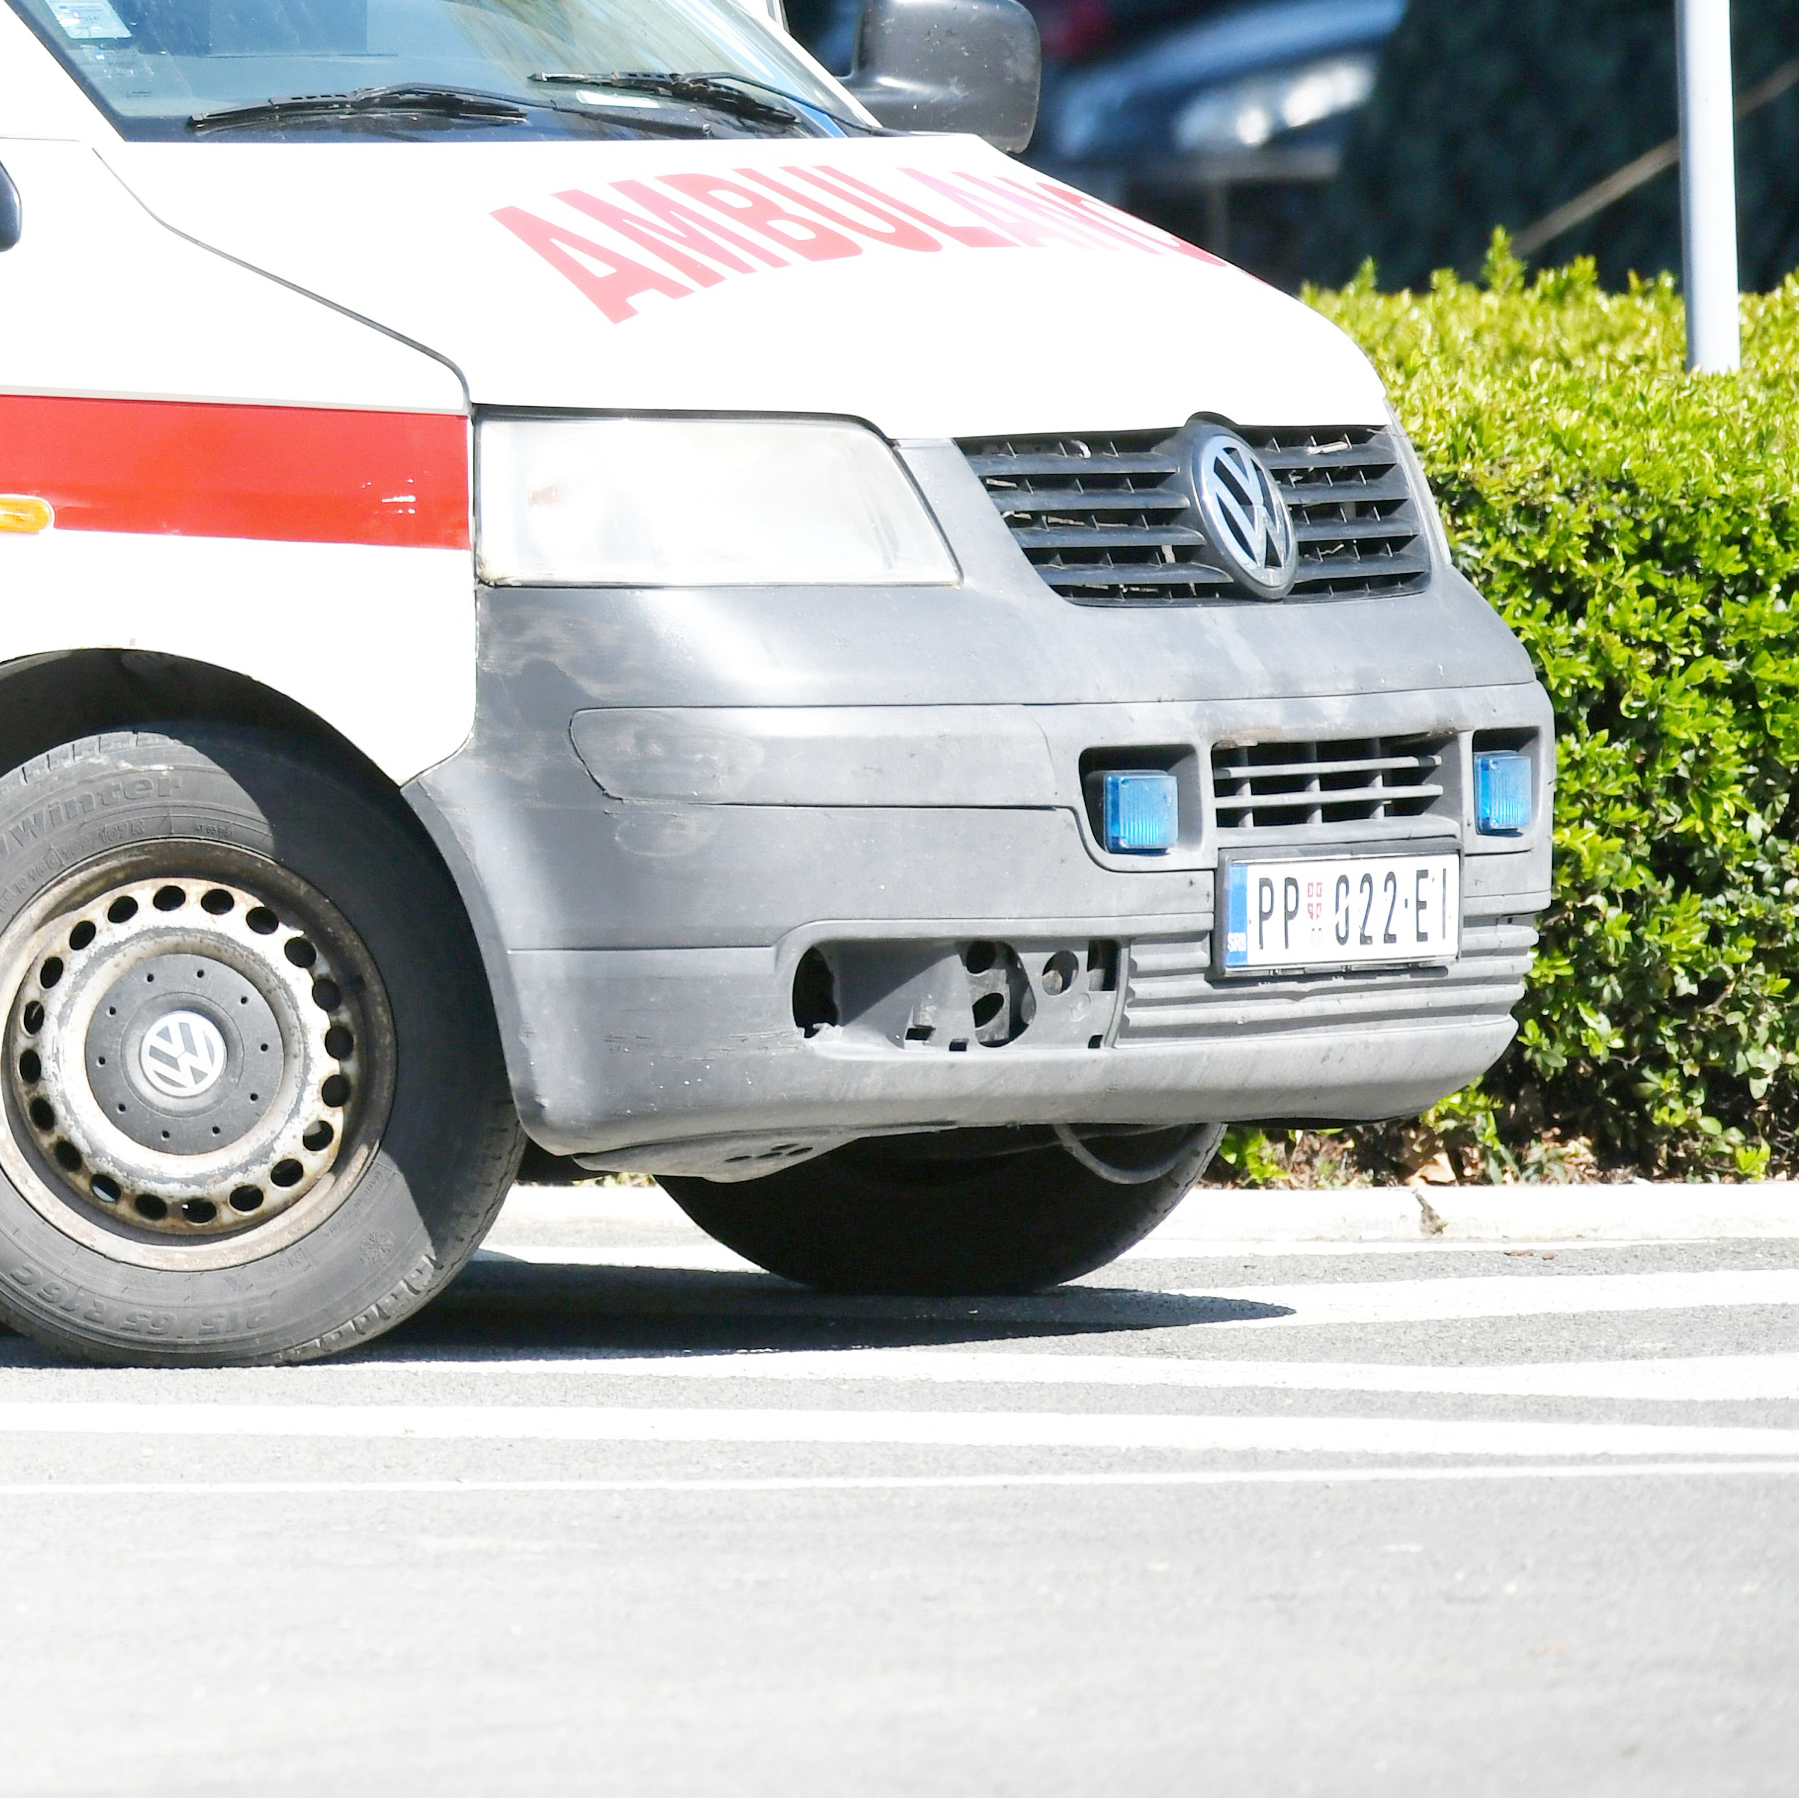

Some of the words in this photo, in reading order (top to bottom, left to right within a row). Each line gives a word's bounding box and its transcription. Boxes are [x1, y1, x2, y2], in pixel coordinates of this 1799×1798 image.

[488, 164, 1270, 324] AMBULANC
[1227, 931, 1247, 952] SRB
[1258, 876, 1300, 950] PP
